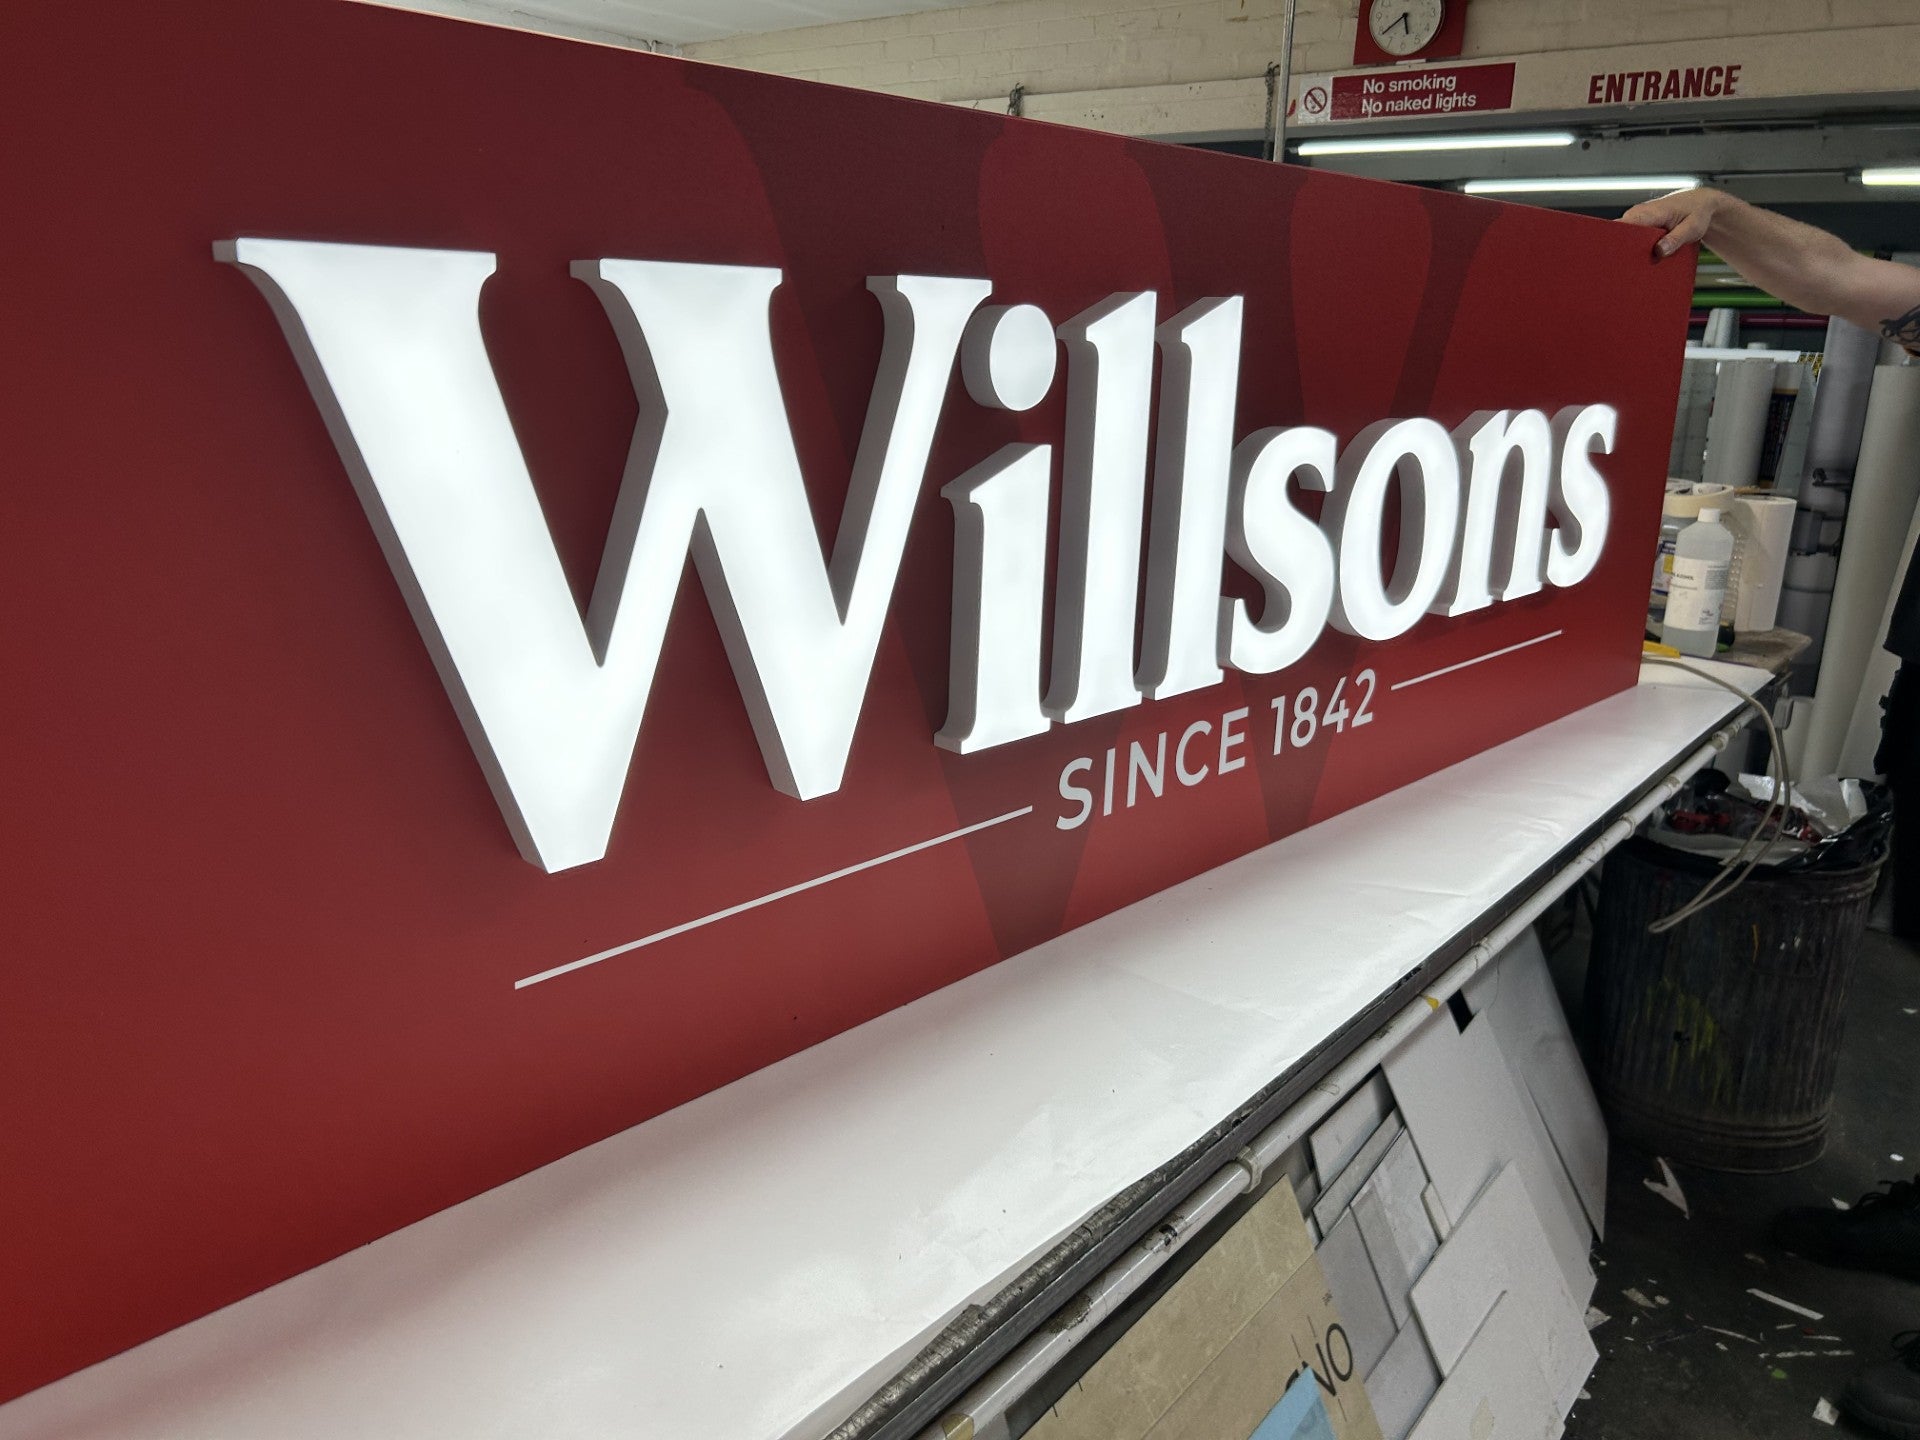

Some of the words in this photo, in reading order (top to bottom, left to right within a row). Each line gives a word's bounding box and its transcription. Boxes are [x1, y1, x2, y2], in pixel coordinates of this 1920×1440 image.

[1361, 98, 1383, 114] No
[1386, 94, 1433, 112] naked
[1435, 92, 1477, 112] lights
[1362, 79, 1385, 94] No
[1389, 74, 1457, 92] smoking
[1588, 65, 1742, 104] ENTRANCE
[213, 237, 1618, 874] Willsons
[1056, 706, 1249, 830] SINCE
[1270, 668, 1377, 755] 1842
